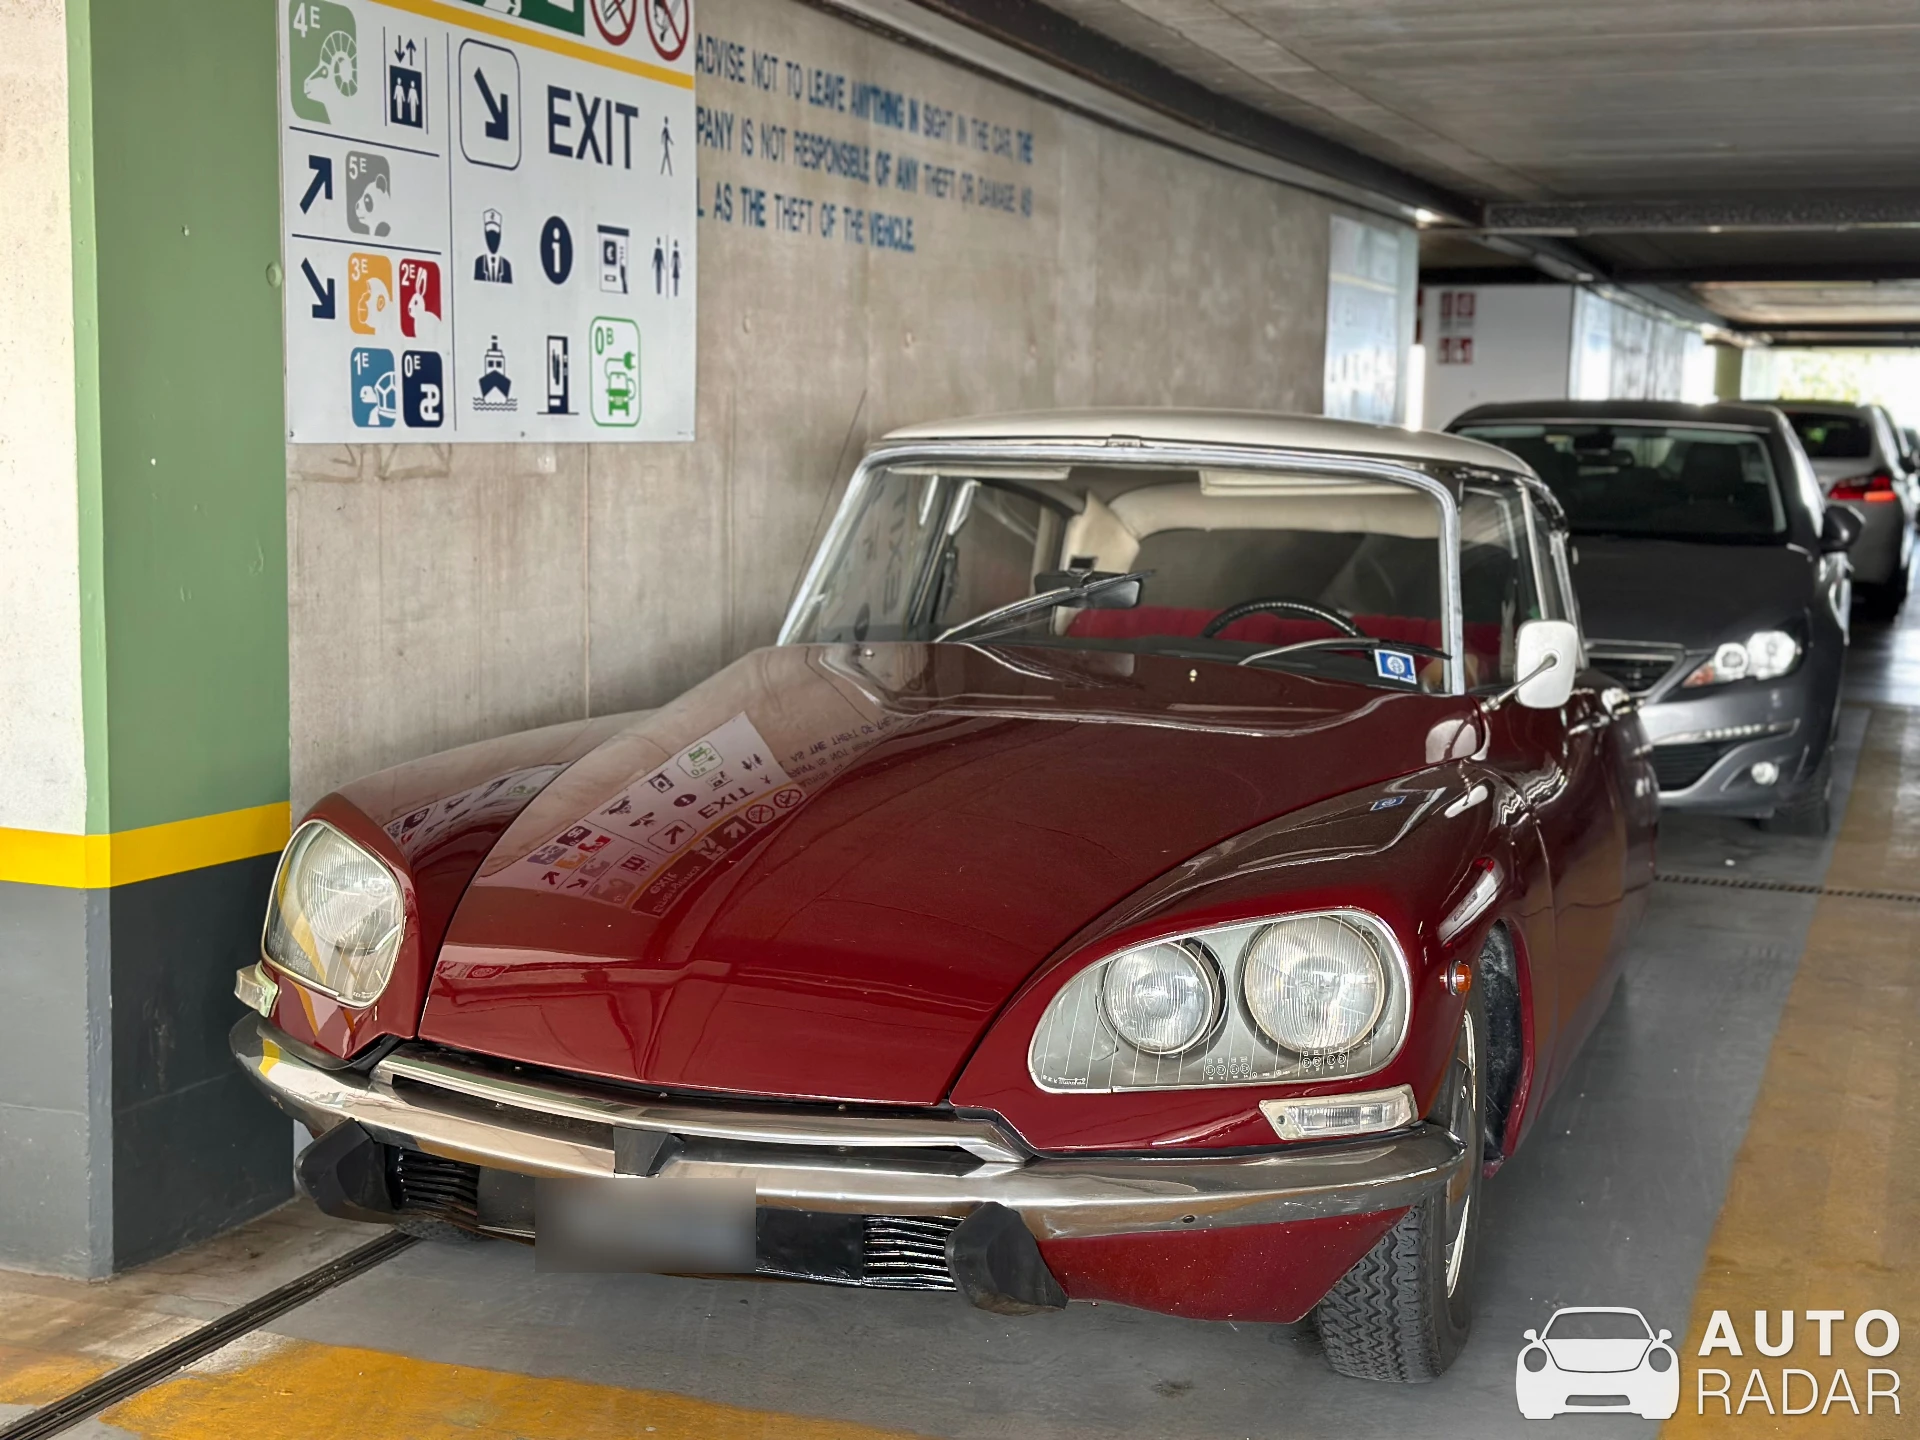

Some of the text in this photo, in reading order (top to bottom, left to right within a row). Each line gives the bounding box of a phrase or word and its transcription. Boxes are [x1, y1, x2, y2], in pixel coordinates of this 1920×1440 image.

[293, 2, 320, 38] 4E
[696, 32, 746, 84] ADVISE
[752, 49, 779, 93] NOT
[786, 60, 804, 100] TO
[808, 66, 845, 113] LEAVE
[547, 84, 639, 170] EXIT
[348, 155, 368, 180] 5E
[696, 105, 735, 151] PANY
[742, 117, 754, 158] IS
[761, 121, 787, 164] NOT
[794, 128, 870, 185] RESPONSIBLE
[876, 149, 891, 188] OF
[896, 156, 919, 194] ANY
[924, 162, 955, 200] THEFT
[714, 180, 733, 222] AS
[740, 186, 766, 228] THE
[774, 193, 813, 235] THEFT
[820, 202, 836, 239] OF
[843, 205, 864, 245] THE
[351, 257, 416, 287] 3E 2E
[353, 351, 421, 378] 1E 0E
